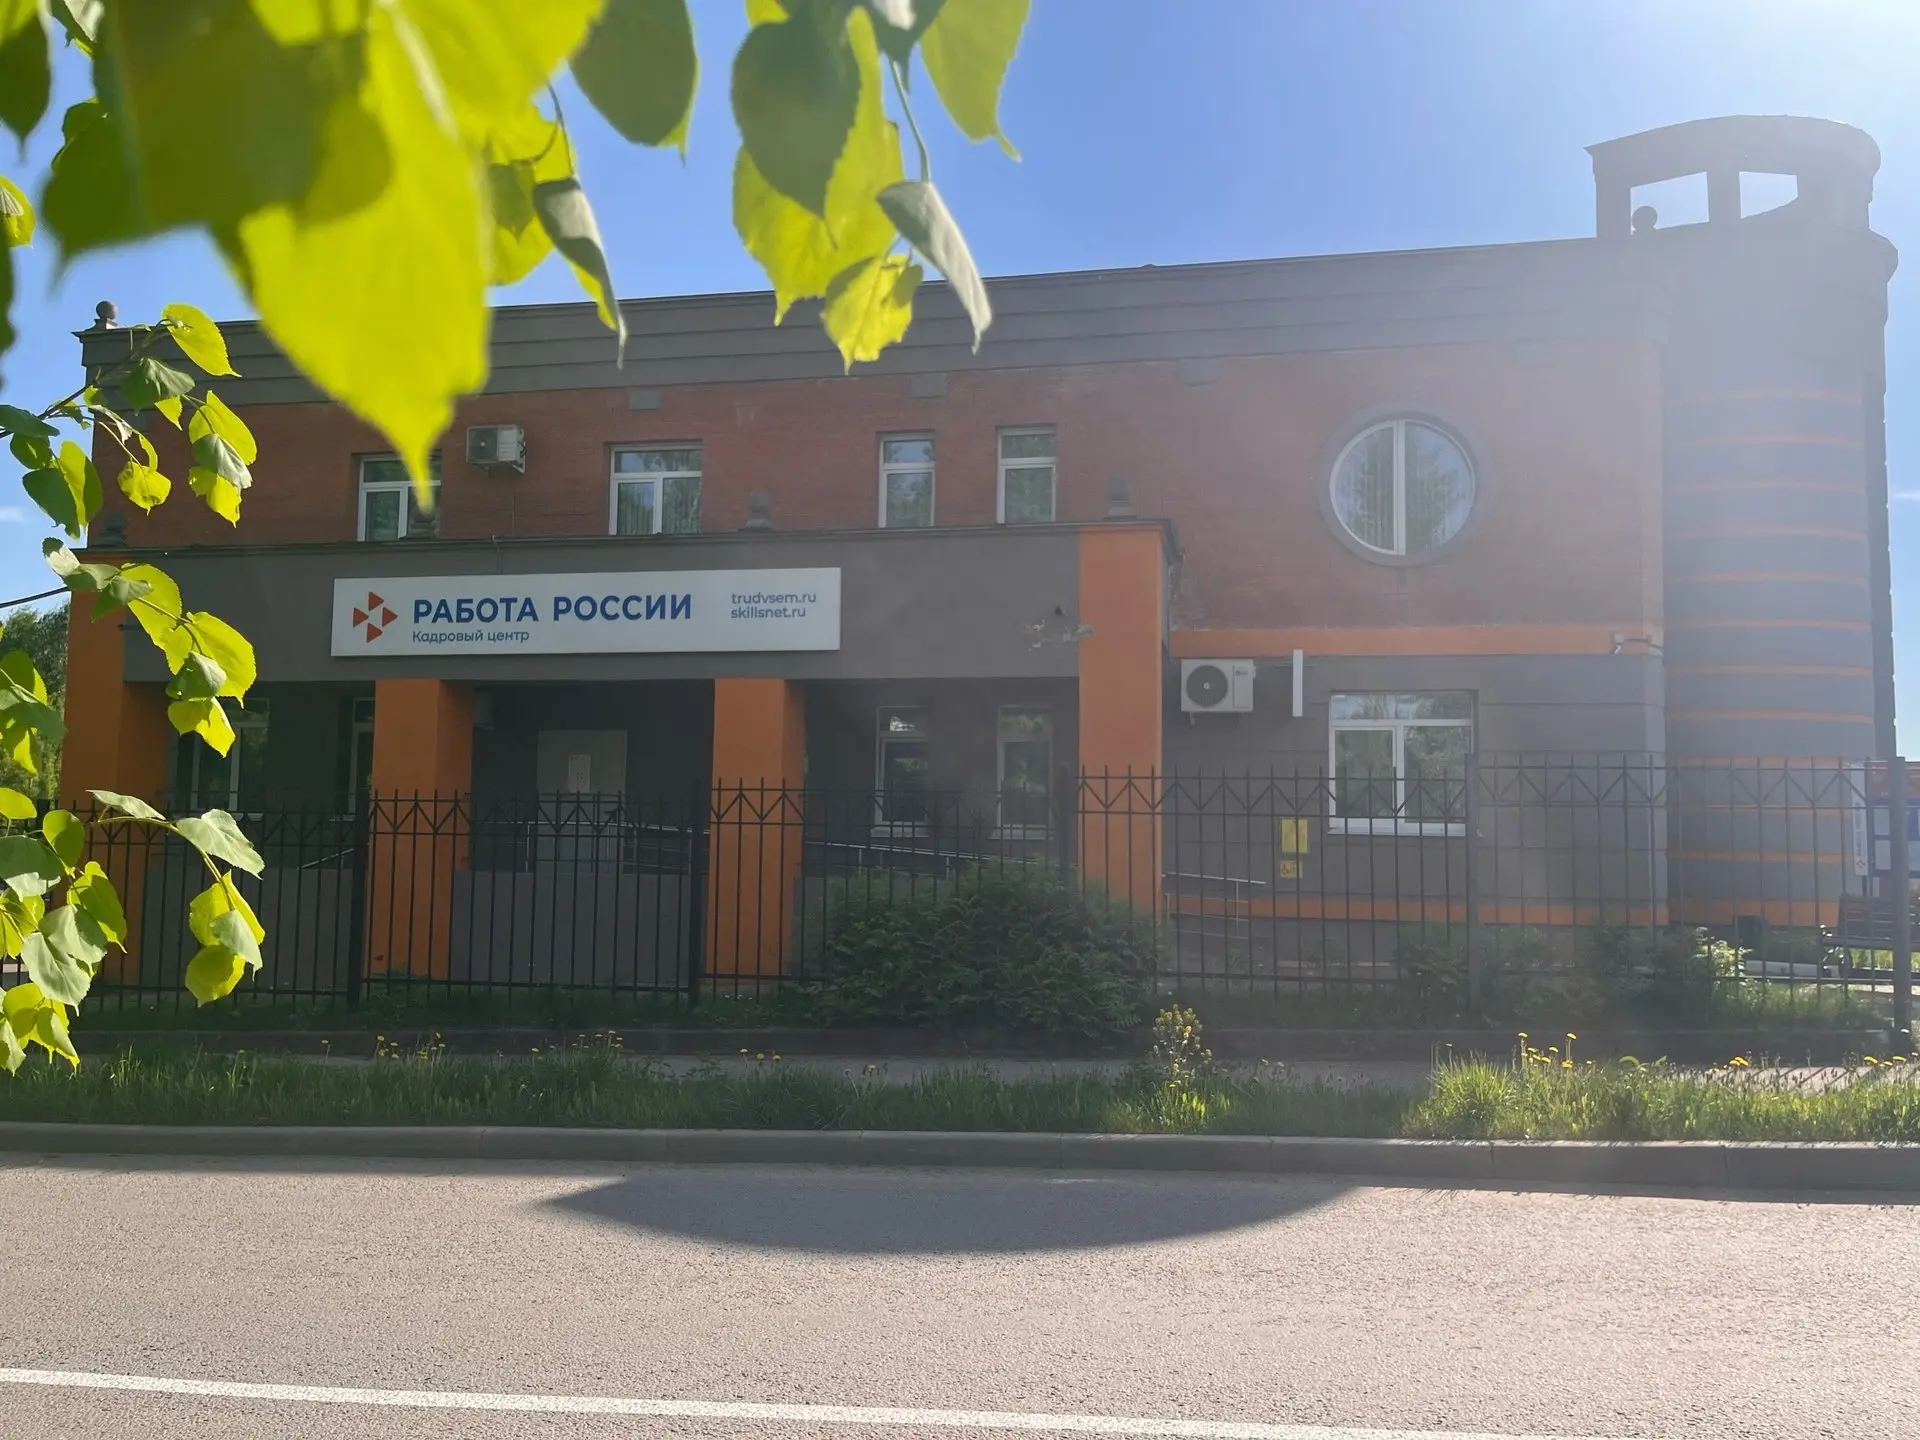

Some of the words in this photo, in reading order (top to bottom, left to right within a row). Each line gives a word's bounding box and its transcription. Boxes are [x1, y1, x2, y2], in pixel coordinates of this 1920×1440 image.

[731, 592, 816, 604] trudvsem.ru
[414, 597, 539, 624] РАБОТА
[553, 594, 692, 621] РОССИИ
[731, 606, 806, 619] skillsnet.ru
[412, 629, 484, 644] Кадровый
[487, 631, 530, 644] центр
